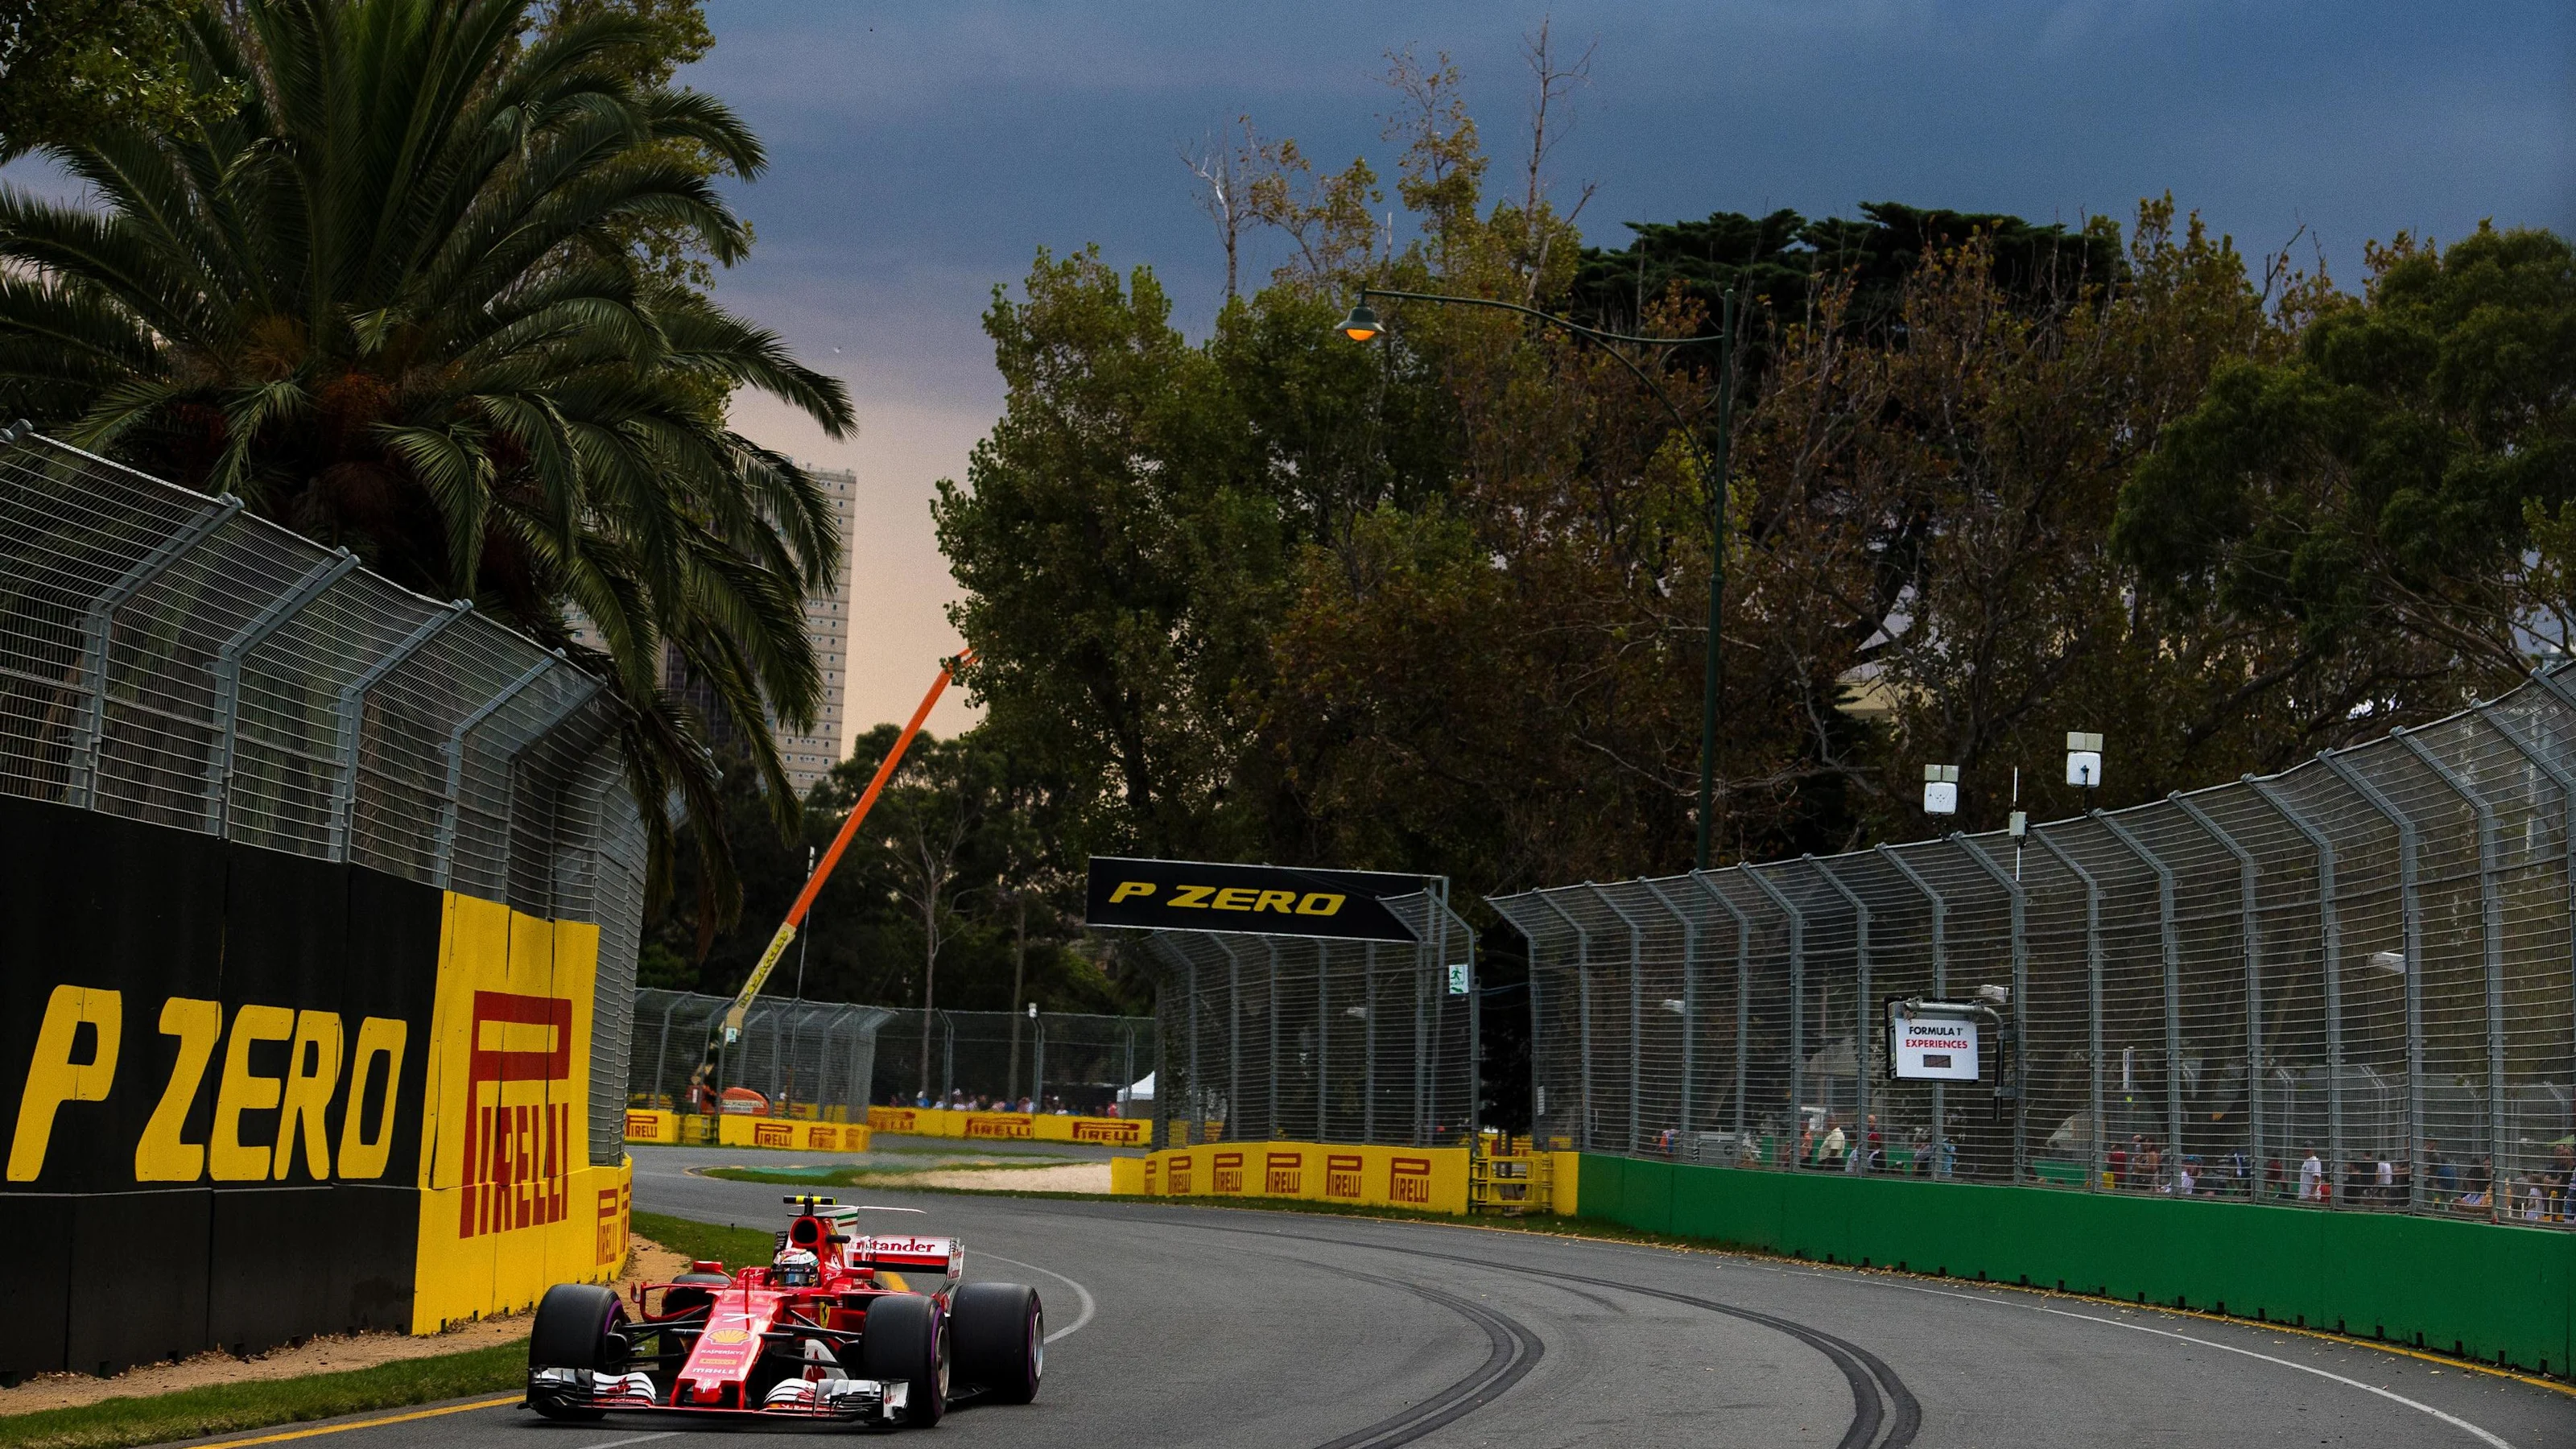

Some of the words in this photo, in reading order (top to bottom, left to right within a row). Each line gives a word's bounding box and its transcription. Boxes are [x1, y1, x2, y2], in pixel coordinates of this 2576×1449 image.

[1108, 881, 1156, 903] P
[1167, 885, 1346, 916] ZERO
[1905, 1039, 1968, 1049] EXPERIENCES
[1909, 1026, 1955, 1035] FORMULA
[6, 985, 122, 1182] P
[135, 997, 407, 1182] ZERO
[460, 990, 572, 1239] PIRELLI
[625, 1115, 658, 1138] PIRELLI
[754, 1123, 793, 1147] PIRELLI
[1073, 1121, 1140, 1142] PIRELLI
[1213, 1153, 1243, 1192] PIRELLI
[1265, 1152, 1302, 1195] PIRELLI
[1327, 1154, 1362, 1198] PIRELLI
[1390, 1158, 1430, 1203] PIRELLI
[856, 1237, 935, 1253] ntander
[722, 1313, 758, 1323] 7
